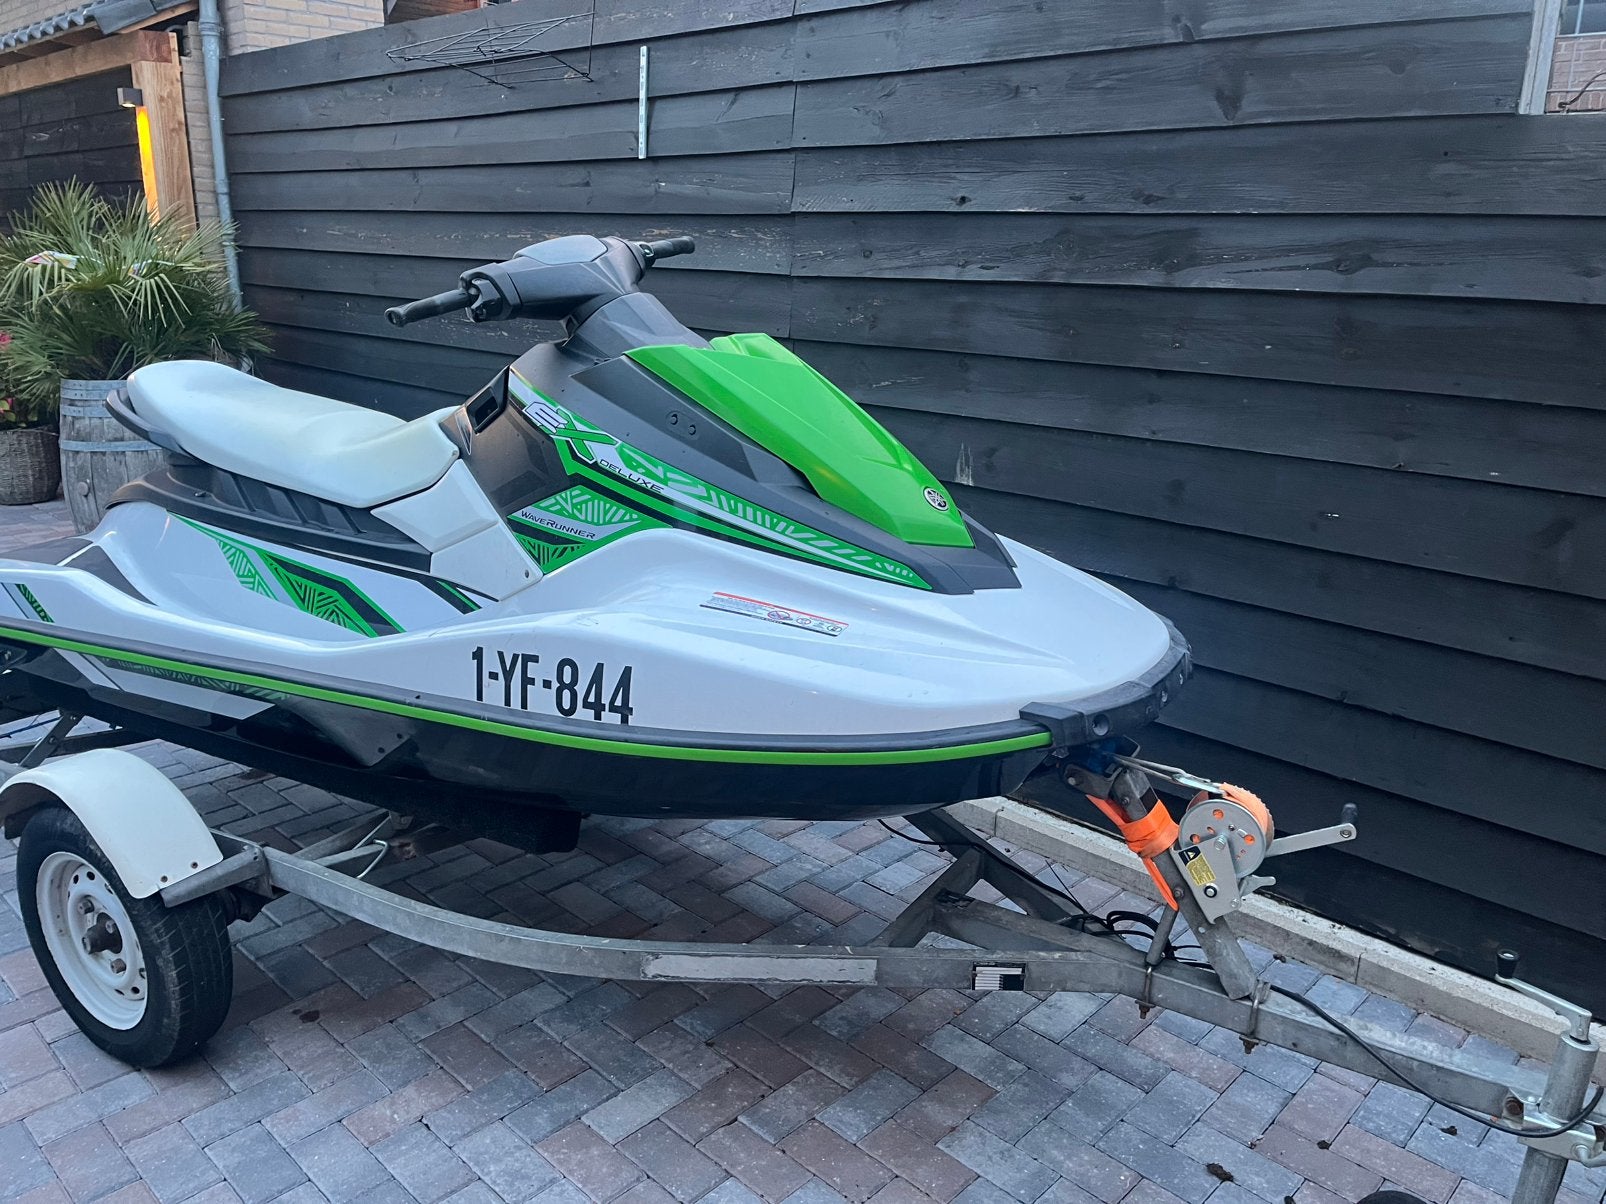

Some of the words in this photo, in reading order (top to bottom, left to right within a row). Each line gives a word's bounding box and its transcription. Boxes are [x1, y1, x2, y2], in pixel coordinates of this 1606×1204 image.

[522, 401, 621, 464] EX
[599, 458, 665, 492] DELUXE
[471, 646, 634, 725] 1-YF-844
